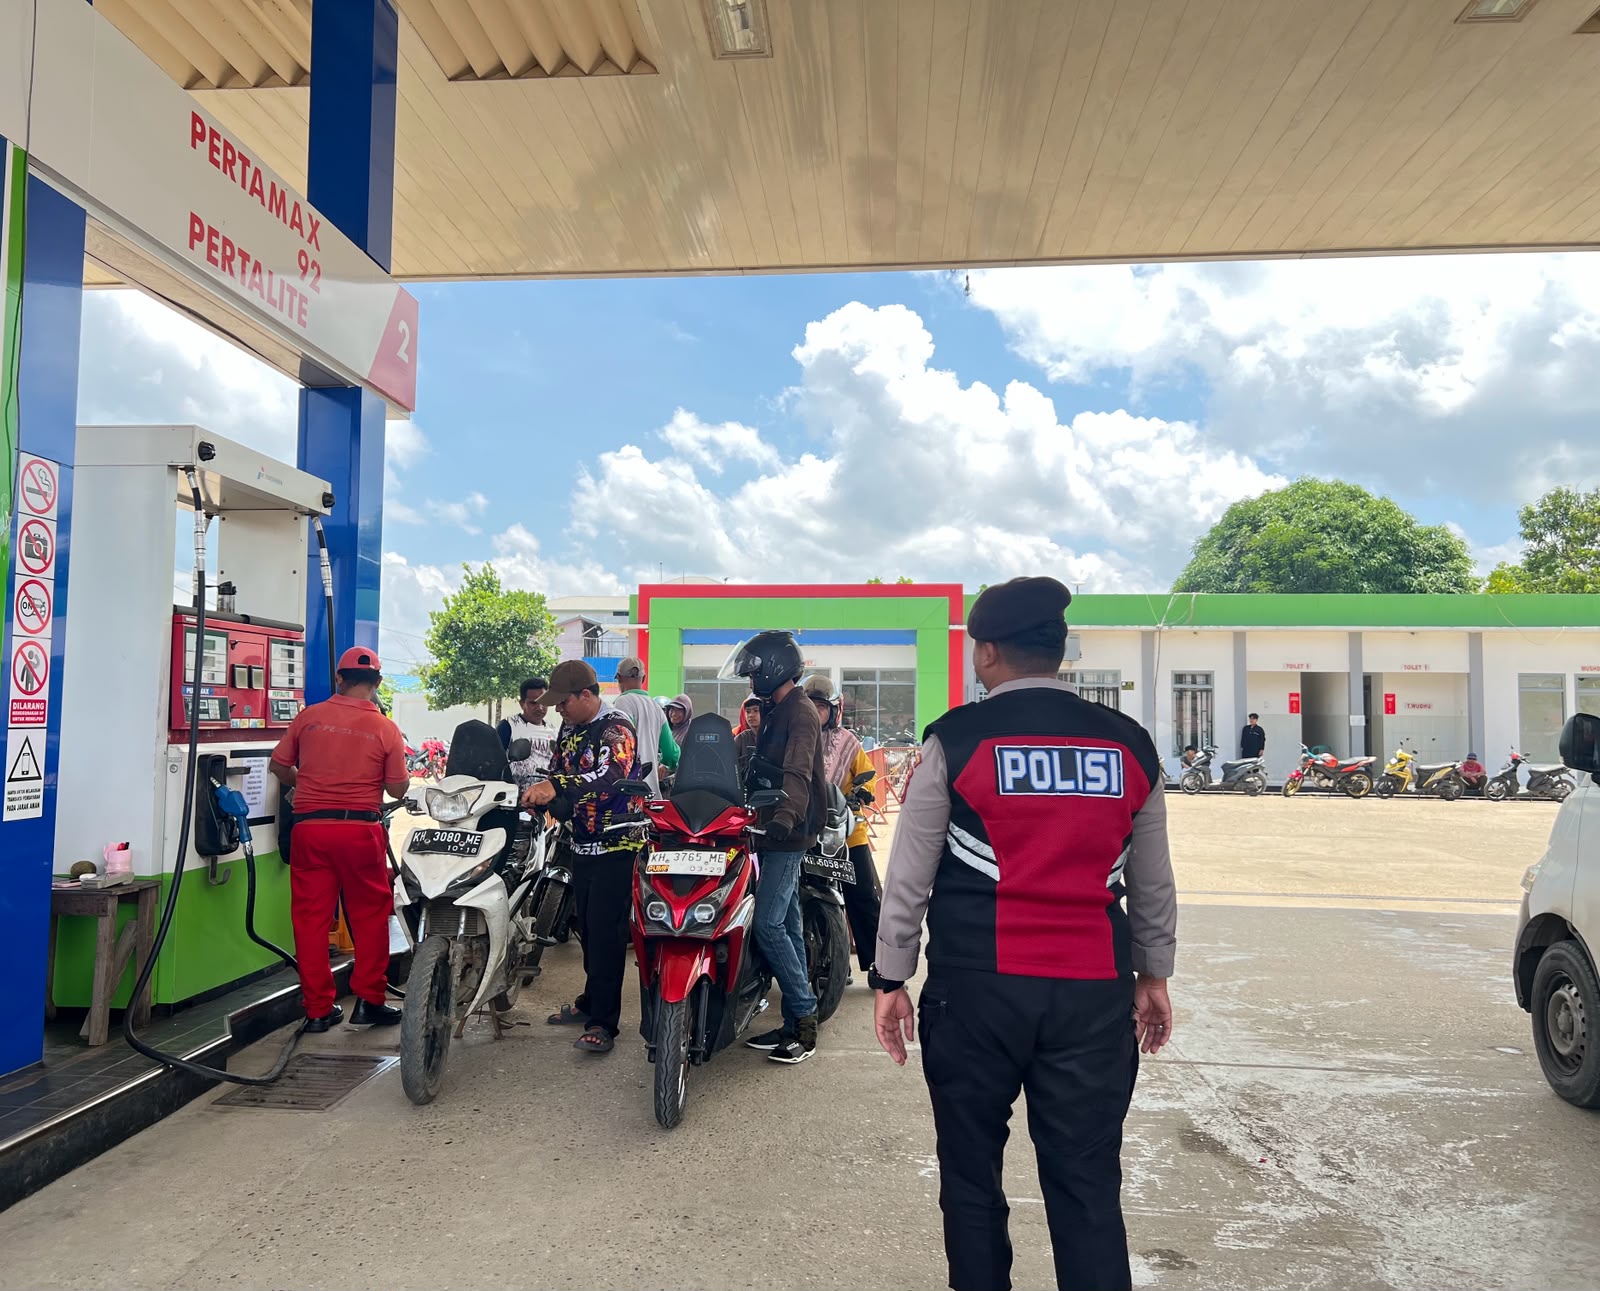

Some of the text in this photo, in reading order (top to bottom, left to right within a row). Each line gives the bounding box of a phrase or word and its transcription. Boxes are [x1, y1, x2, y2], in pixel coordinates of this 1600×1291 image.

[190, 110, 321, 252] PERTAMAX
[188, 211, 309, 329] PERTALITE
[297, 249, 321, 295] 92
[396, 319, 410, 364] 2
[12, 702, 45, 710] DILARANG
[1002, 750, 1119, 793] POLISI
[413, 831, 482, 845] KH 3080 ME
[651, 853, 666, 863] KH
[673, 852, 702, 862] 3765
[709, 853, 725, 863] ME
